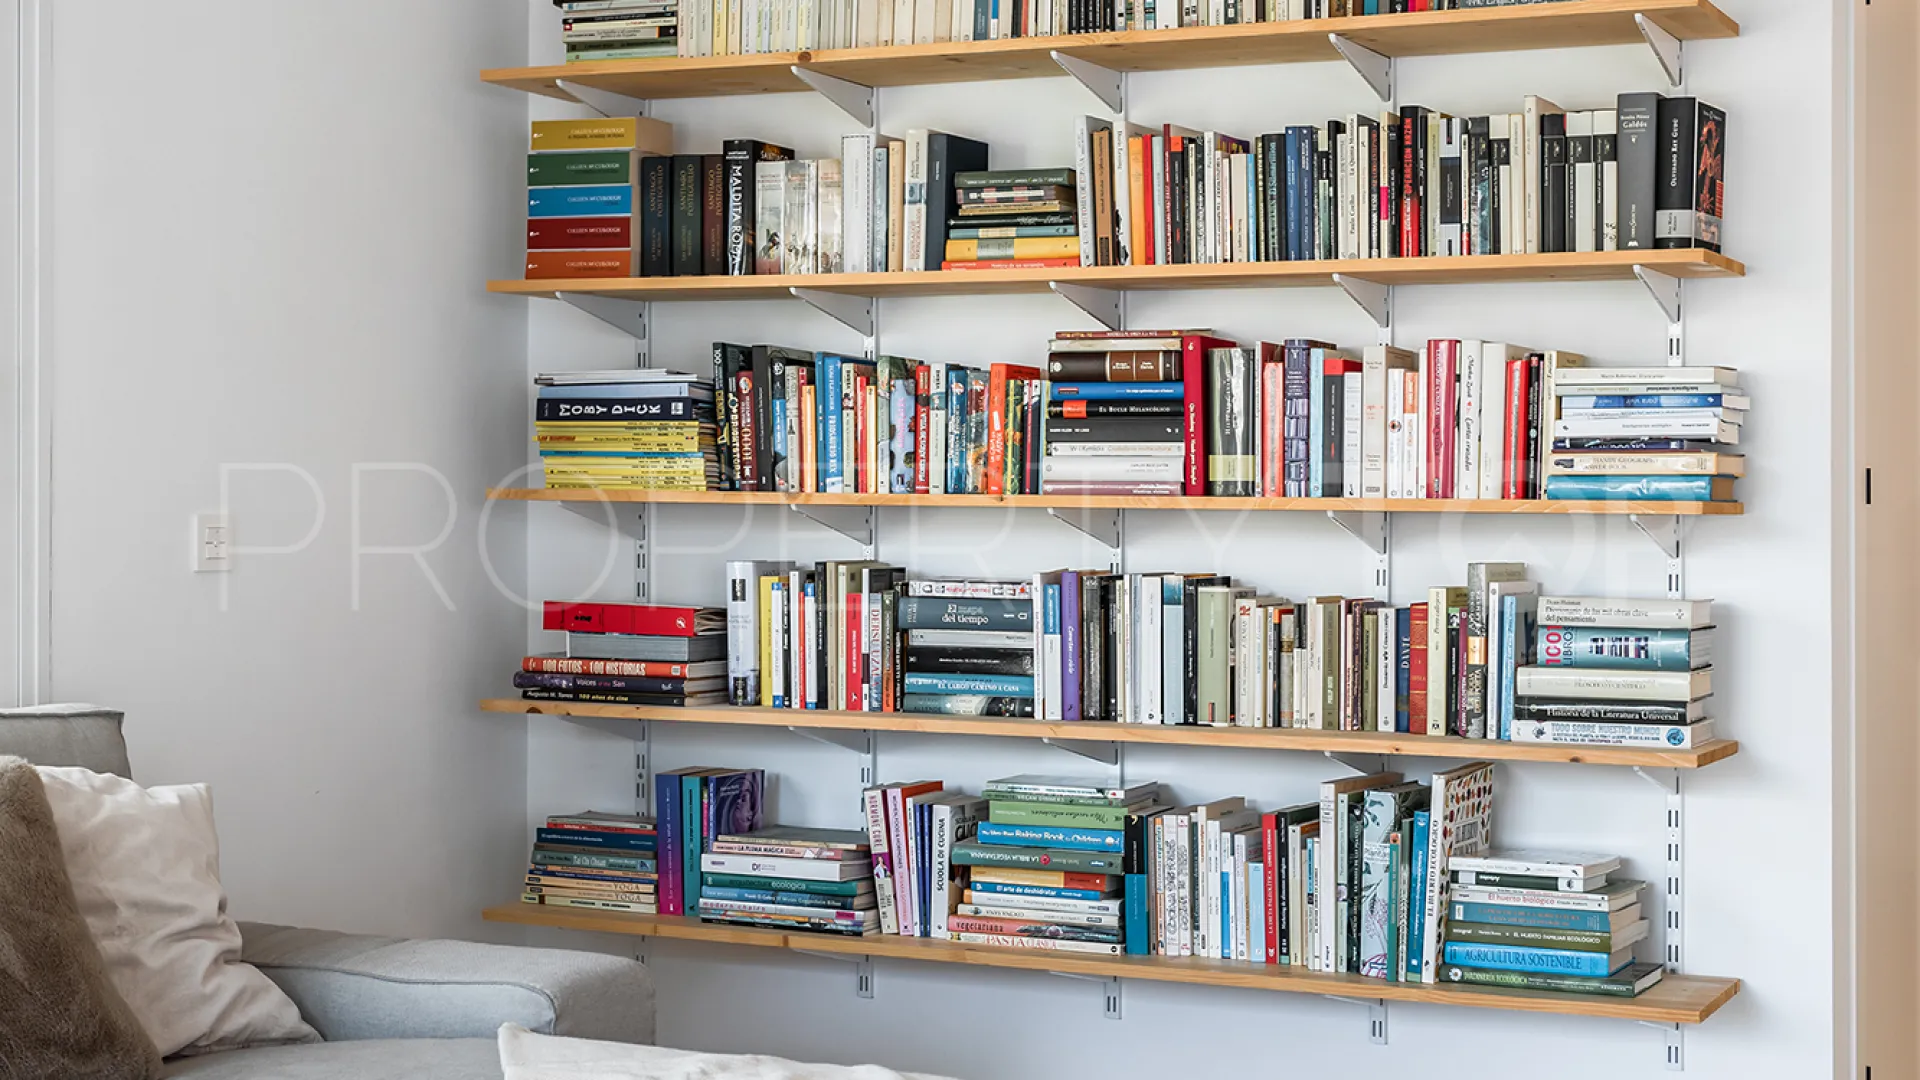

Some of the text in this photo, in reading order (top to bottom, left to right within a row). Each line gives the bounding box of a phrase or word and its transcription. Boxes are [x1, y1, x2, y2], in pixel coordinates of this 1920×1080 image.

[732, 165, 742, 222] MALDITA
[558, 403, 661, 416] MOBY DICK
[942, 614, 988, 626] del tiempo
[1545, 614, 1596, 624] del pensamiento
[872, 608, 880, 687] DERSU UZALA
[1545, 626, 1562, 666] 1001
[1562, 626, 1574, 667] LIBROS
[1401, 636, 1410, 669] DANTE
[558, 660, 582, 673] FOTOS
[606, 662, 646, 676] HISTORIAS
[1547, 709, 1679, 721] Historia de la Literatura Universal
[872, 830, 883, 848] CURE
[938, 818, 946, 848] CUCINA
[938, 850, 944, 858] DI
[1426, 820, 1439, 917] EL HUERTO ECOLÓGICO
[612, 884, 640, 892] YOGA
[772, 881, 806, 890] ecológica
[614, 894, 642, 902] YOGA
[1496, 894, 1520, 902] huerto
[1522, 895, 1555, 905] biológico
[737, 904, 766, 912] chairs
[956, 922, 1004, 932] vegetariana
[986, 936, 1025, 947] PASTA
[1567, 936, 1600, 944] ECOLÓGICO
[1464, 948, 1582, 970] AGRICULTURA SOSTENIBLE
